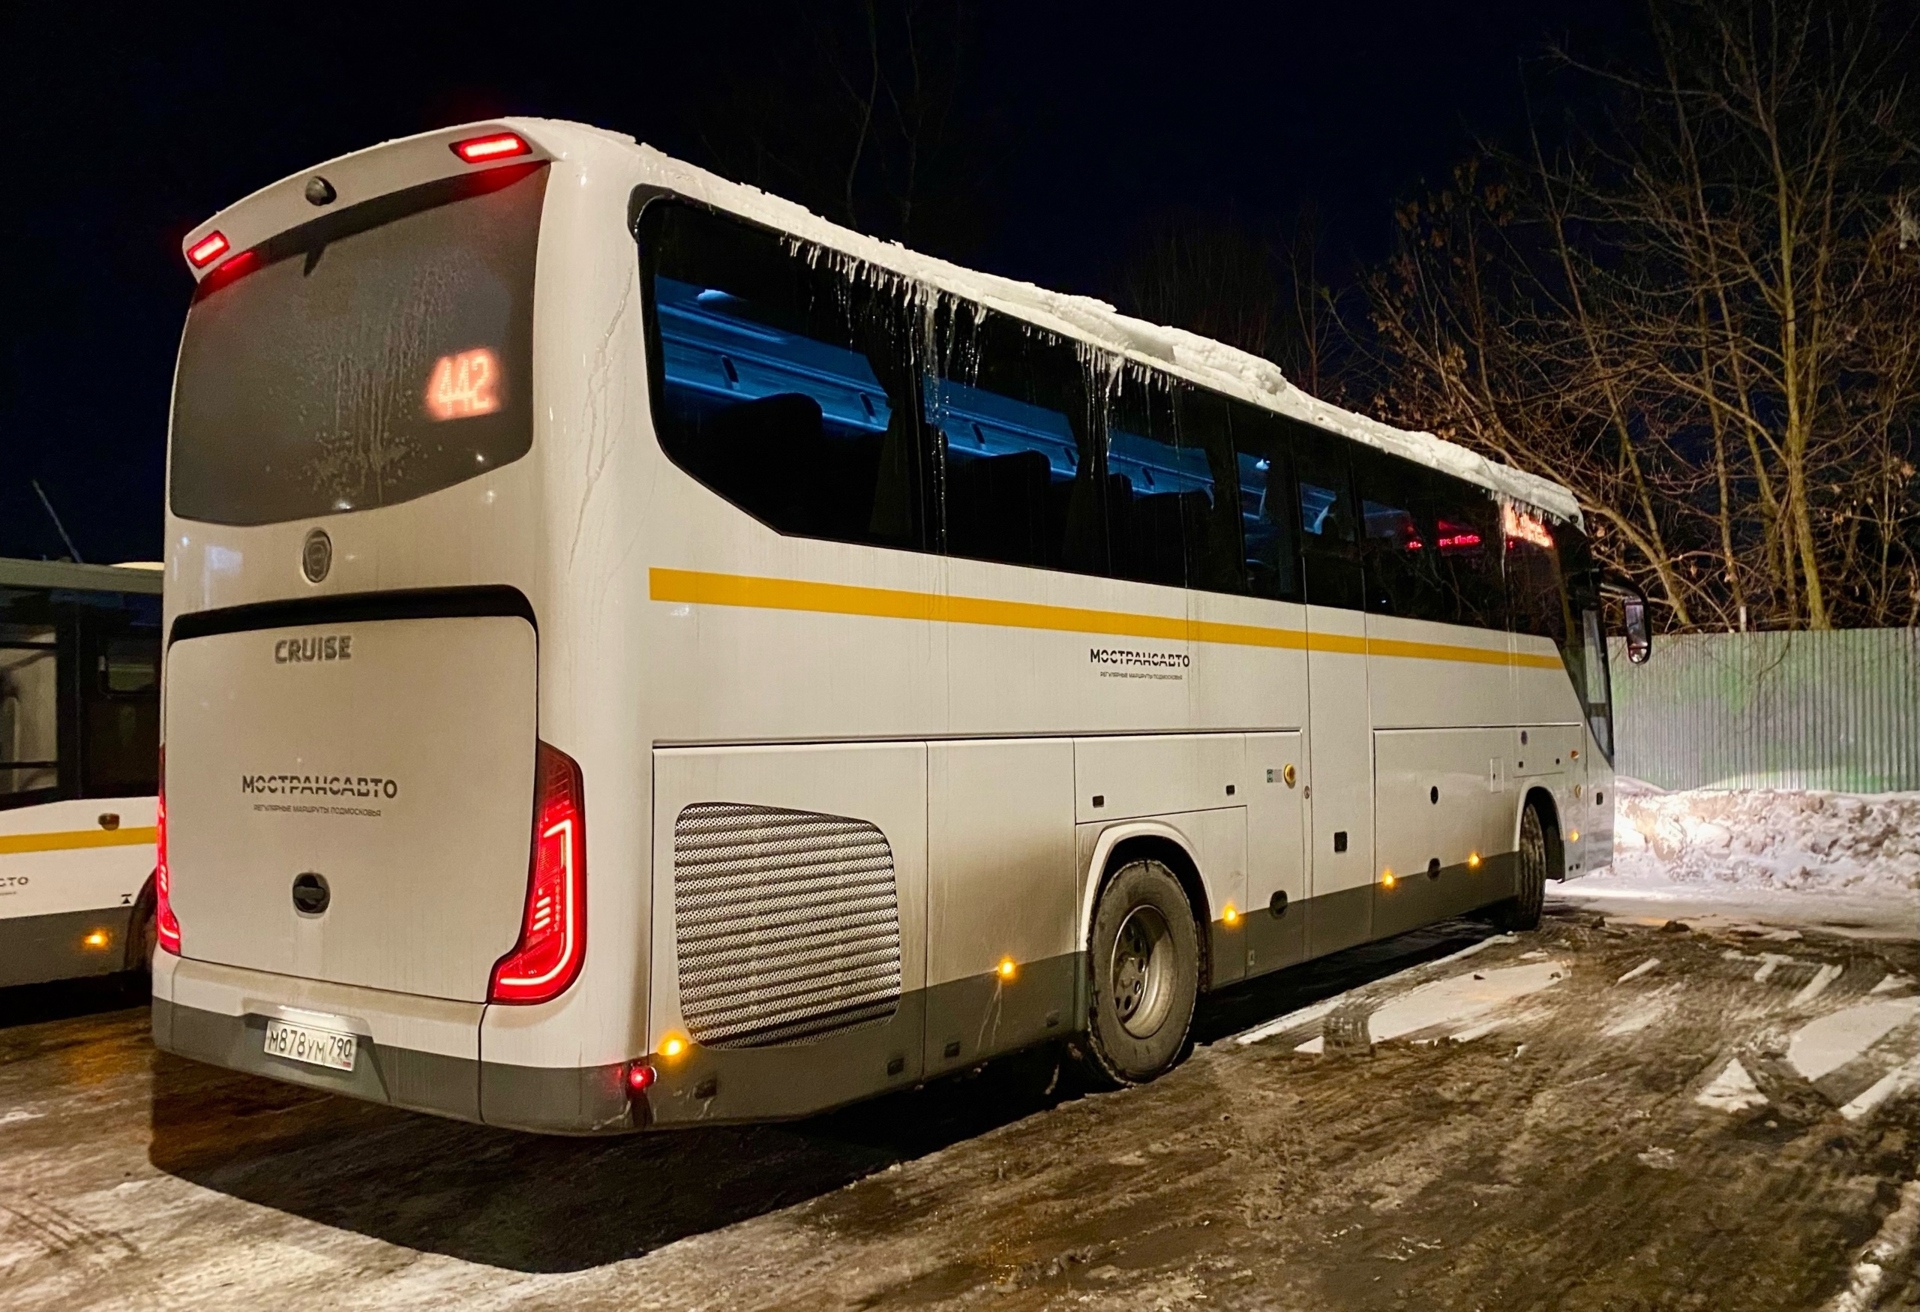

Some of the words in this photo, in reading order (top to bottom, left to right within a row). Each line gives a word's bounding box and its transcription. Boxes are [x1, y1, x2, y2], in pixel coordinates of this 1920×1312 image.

[438, 354, 490, 416] 442
[275, 635, 352, 664] CRUISE
[1090, 648, 1190, 668] МОСТРАНСАВТО
[242, 775, 398, 799] МОСТРАНСАВТО
[293, 805, 329, 815] МАРШРУТЫ
[330, 806, 382, 817] ПОДМОСКОВЬЯ
